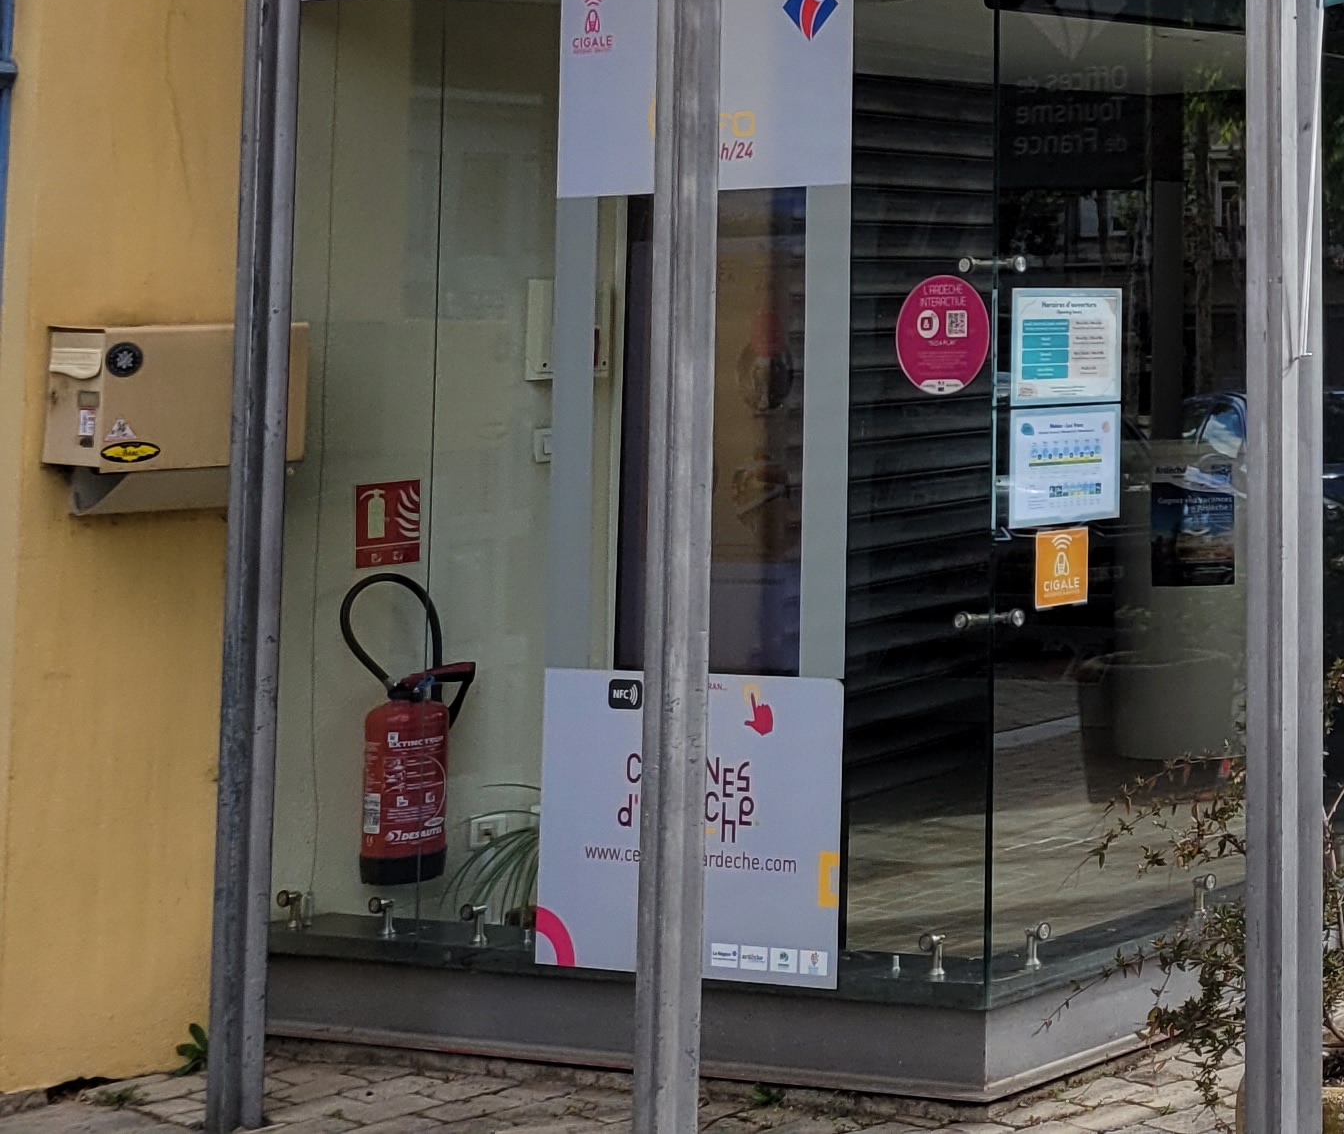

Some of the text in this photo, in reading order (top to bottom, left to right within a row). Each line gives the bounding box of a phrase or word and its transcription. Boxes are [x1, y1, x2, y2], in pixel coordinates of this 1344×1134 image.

[573, 35, 612, 48] CIGALE
[1043, 577, 1080, 592] CIGALE
[613, 689, 629, 700] NFC
